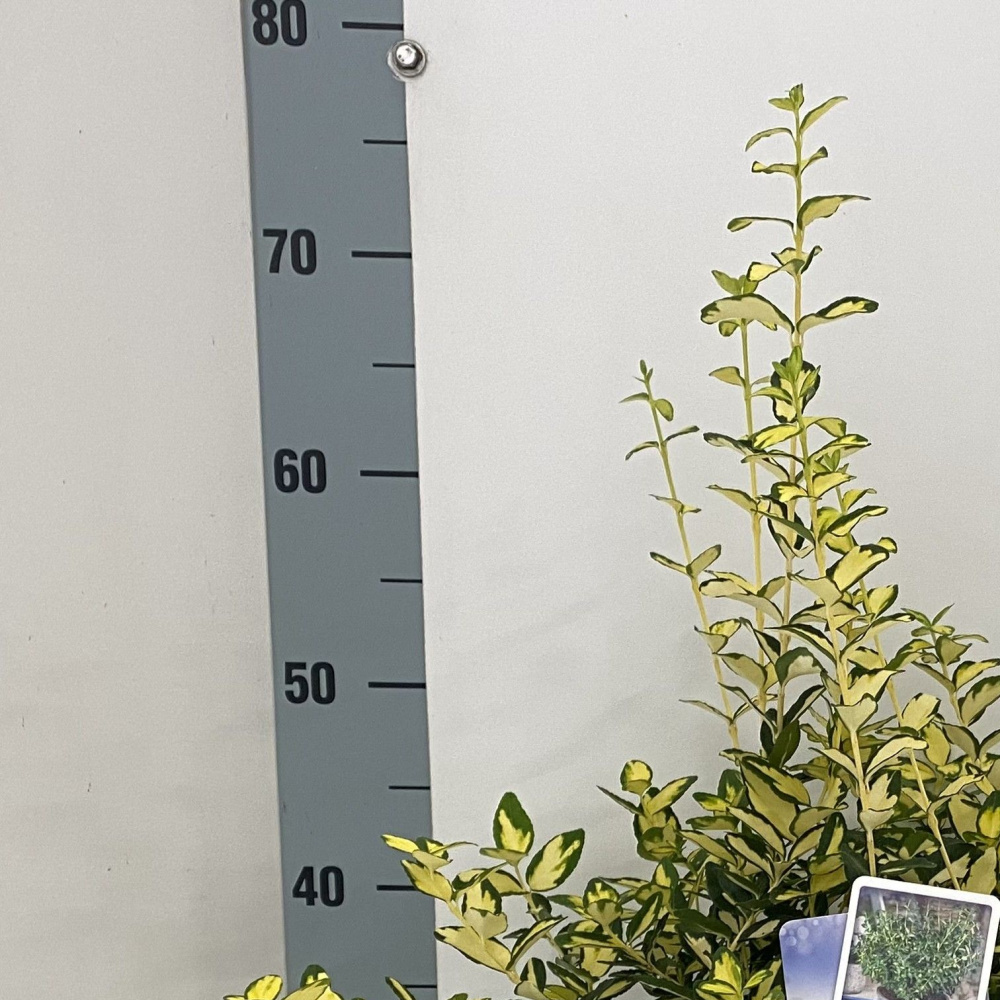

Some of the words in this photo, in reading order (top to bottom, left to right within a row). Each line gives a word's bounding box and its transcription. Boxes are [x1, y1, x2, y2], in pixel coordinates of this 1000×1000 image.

[252, 0, 308, 47] 80
[262, 228, 317, 275] 70
[273, 448, 327, 494] 60
[284, 661, 336, 705] 50
[292, 866, 345, 907] 40
